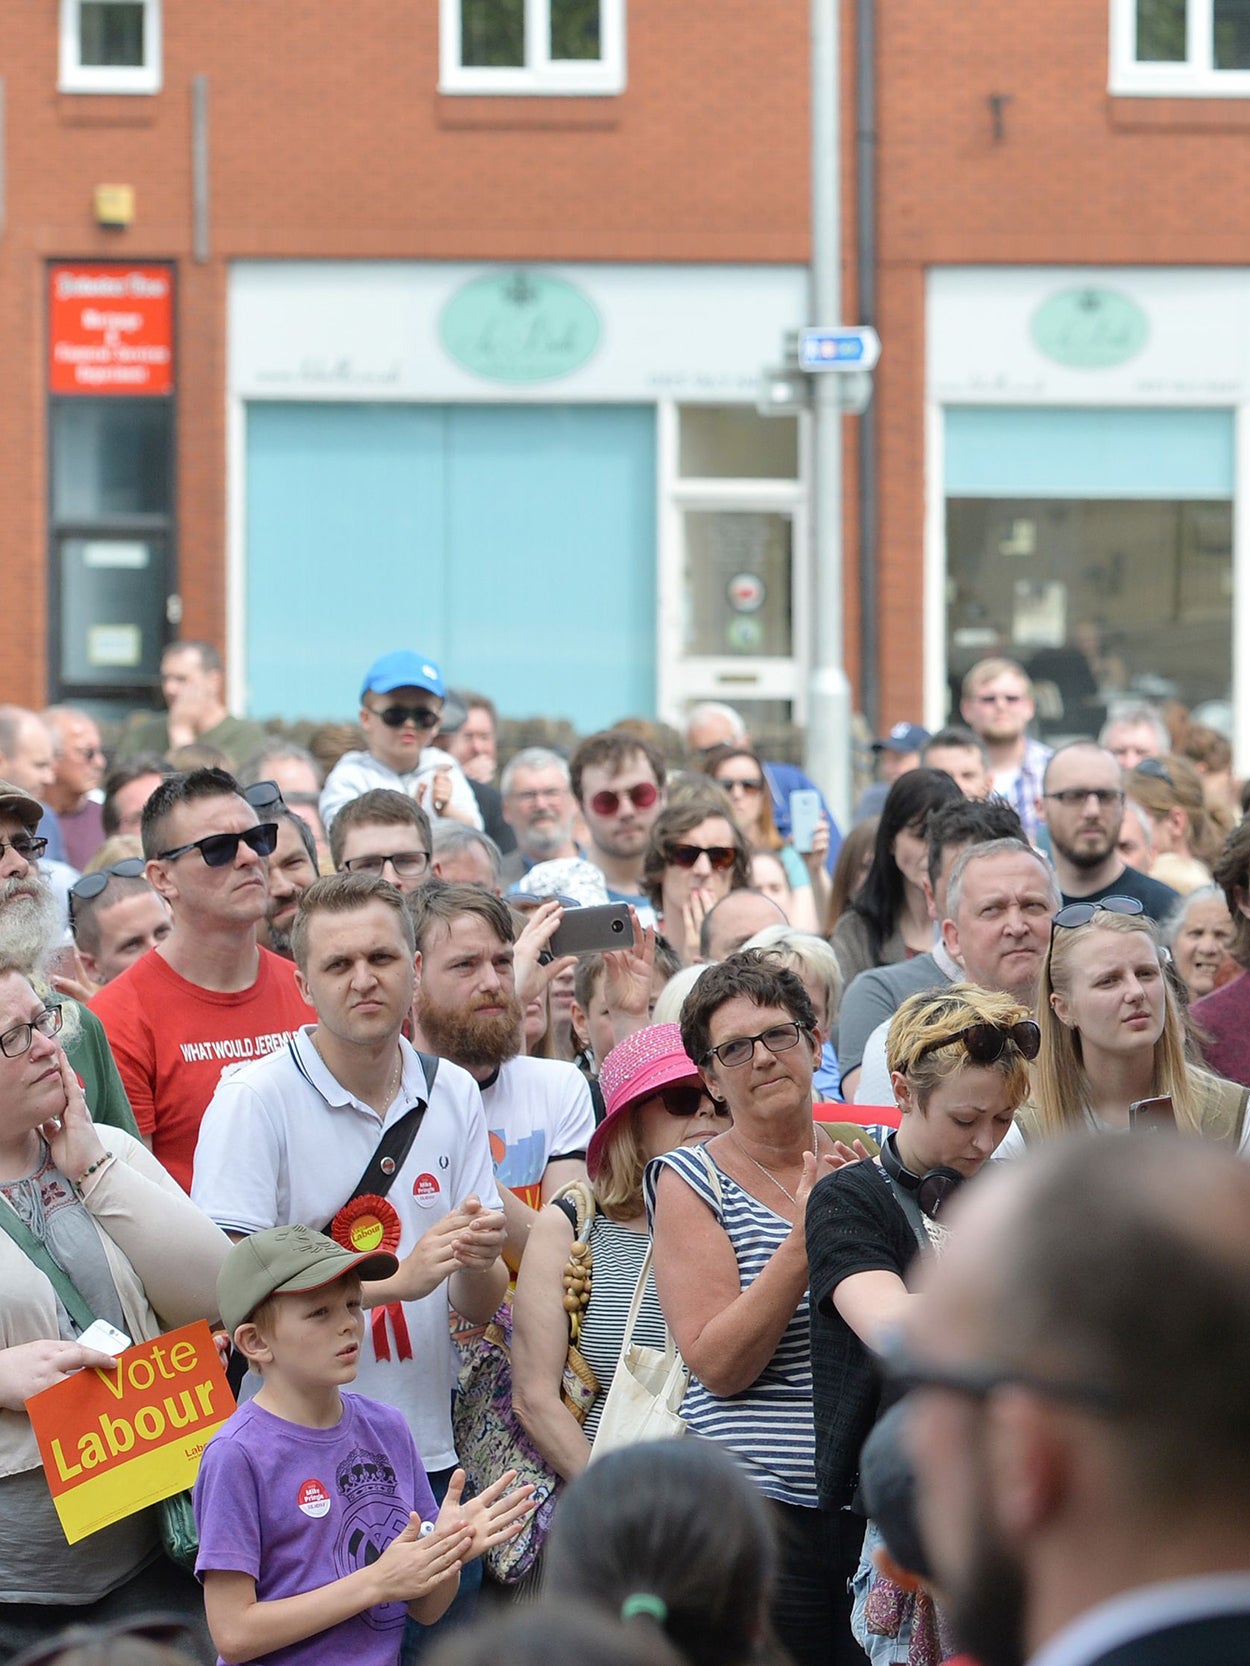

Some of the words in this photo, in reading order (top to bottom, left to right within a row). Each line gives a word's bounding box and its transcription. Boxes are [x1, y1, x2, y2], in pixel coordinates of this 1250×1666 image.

[180, 1041, 213, 1062] WHAT
[212, 1038, 253, 1059] WOULD
[352, 1223, 381, 1242] Labour
[95, 1341, 198, 1400] Vote
[51, 1380, 214, 1482] Labour
